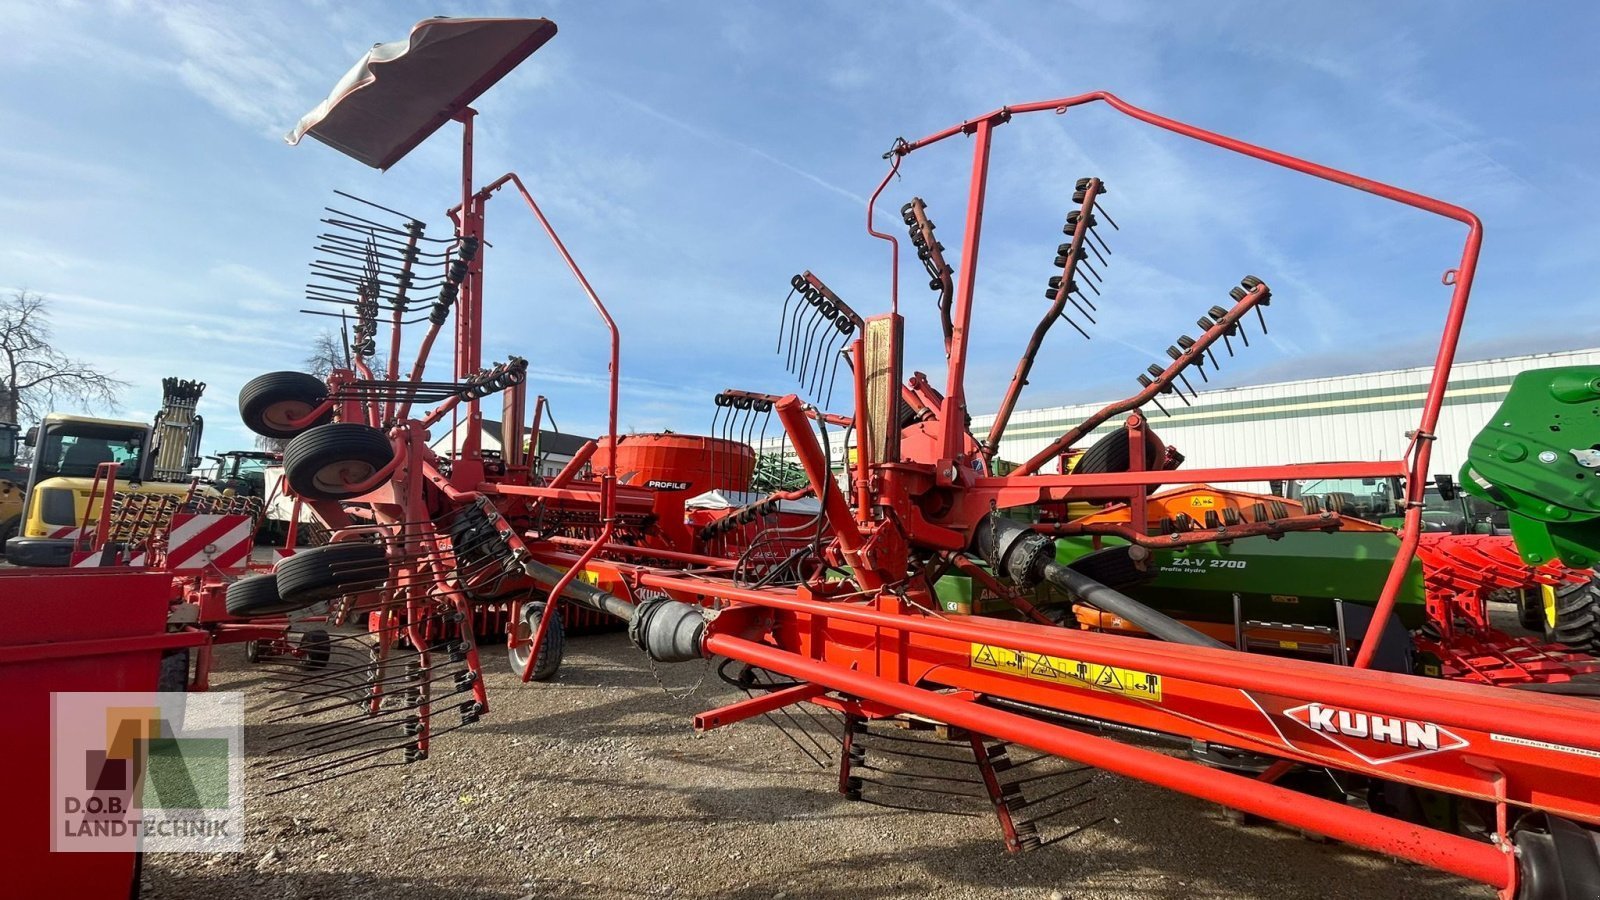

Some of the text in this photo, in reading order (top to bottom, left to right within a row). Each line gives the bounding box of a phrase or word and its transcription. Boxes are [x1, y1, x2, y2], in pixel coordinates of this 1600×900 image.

[648, 480, 687, 490] PROFILE
[1172, 558, 1247, 569] ZA-V 2700
[1308, 705, 1439, 751] KUHN
